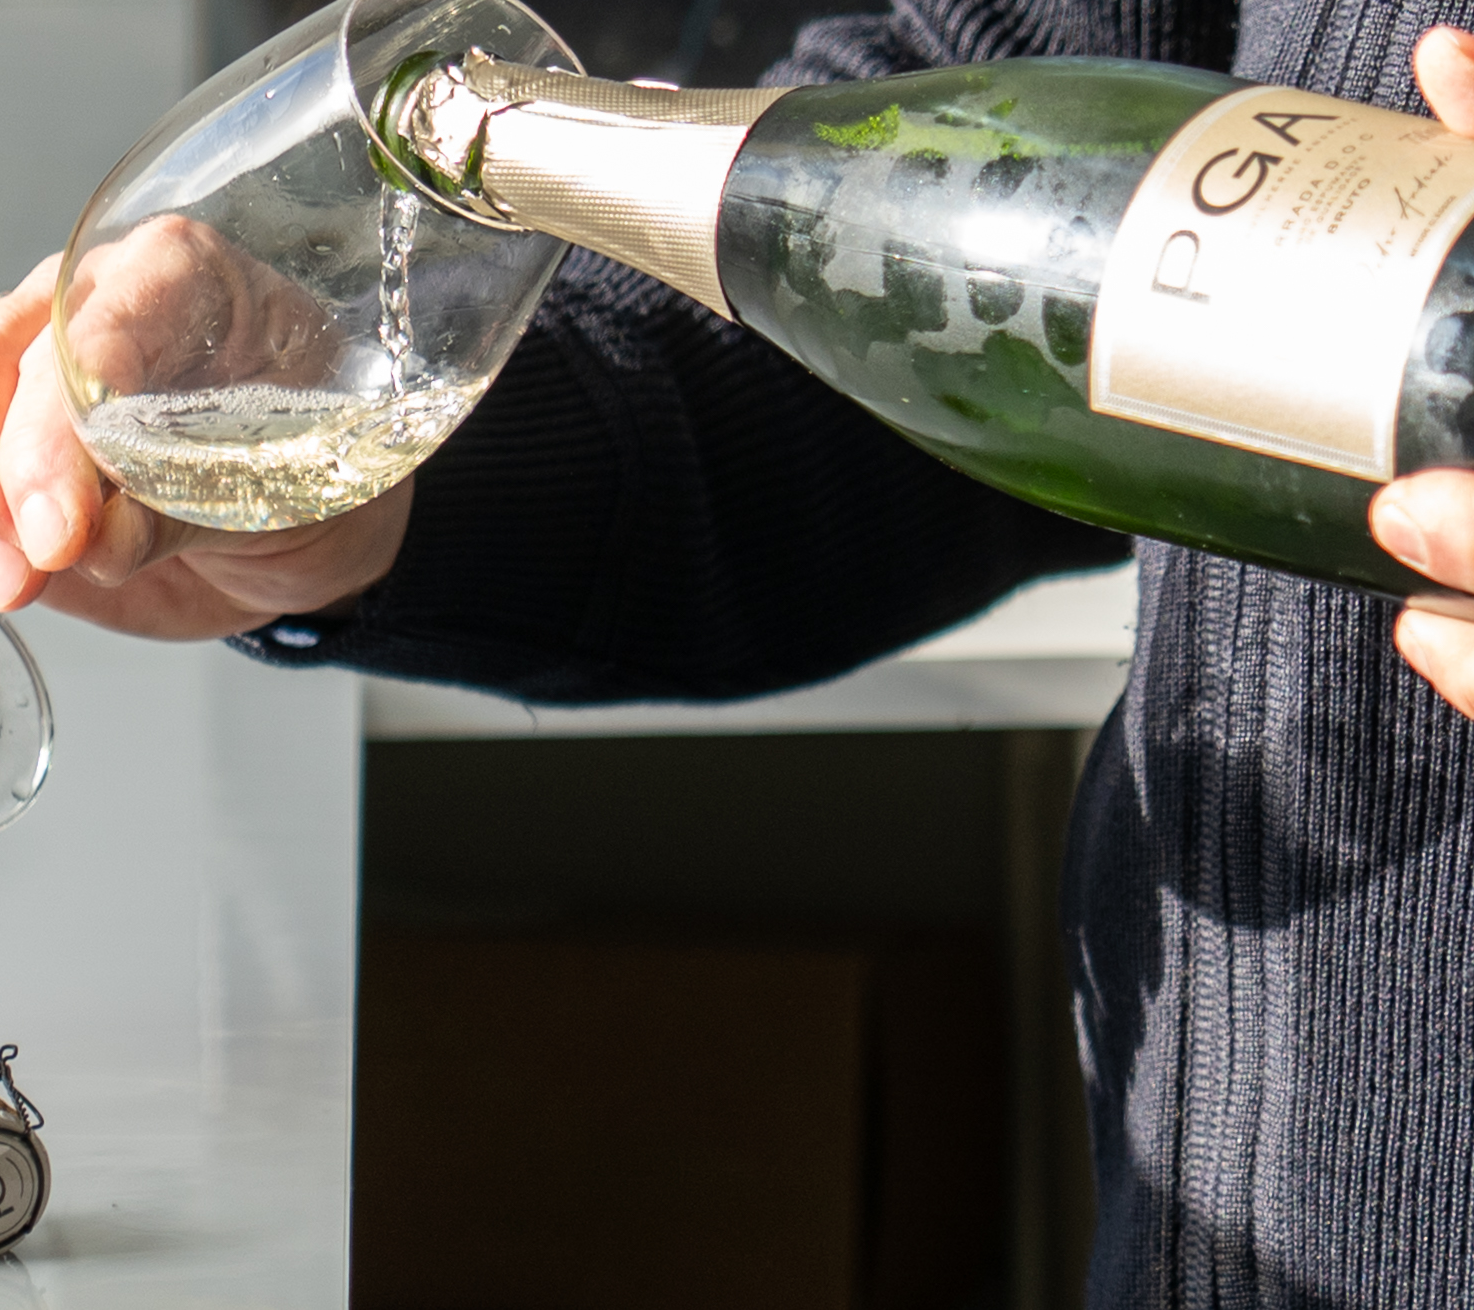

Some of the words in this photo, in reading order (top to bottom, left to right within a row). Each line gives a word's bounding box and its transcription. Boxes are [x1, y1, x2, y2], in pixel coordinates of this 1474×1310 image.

[1150, 110, 1342, 306] PGA
[1274, 178, 1324, 247] RRADA
[1326, 177, 1371, 234] BRUTO
